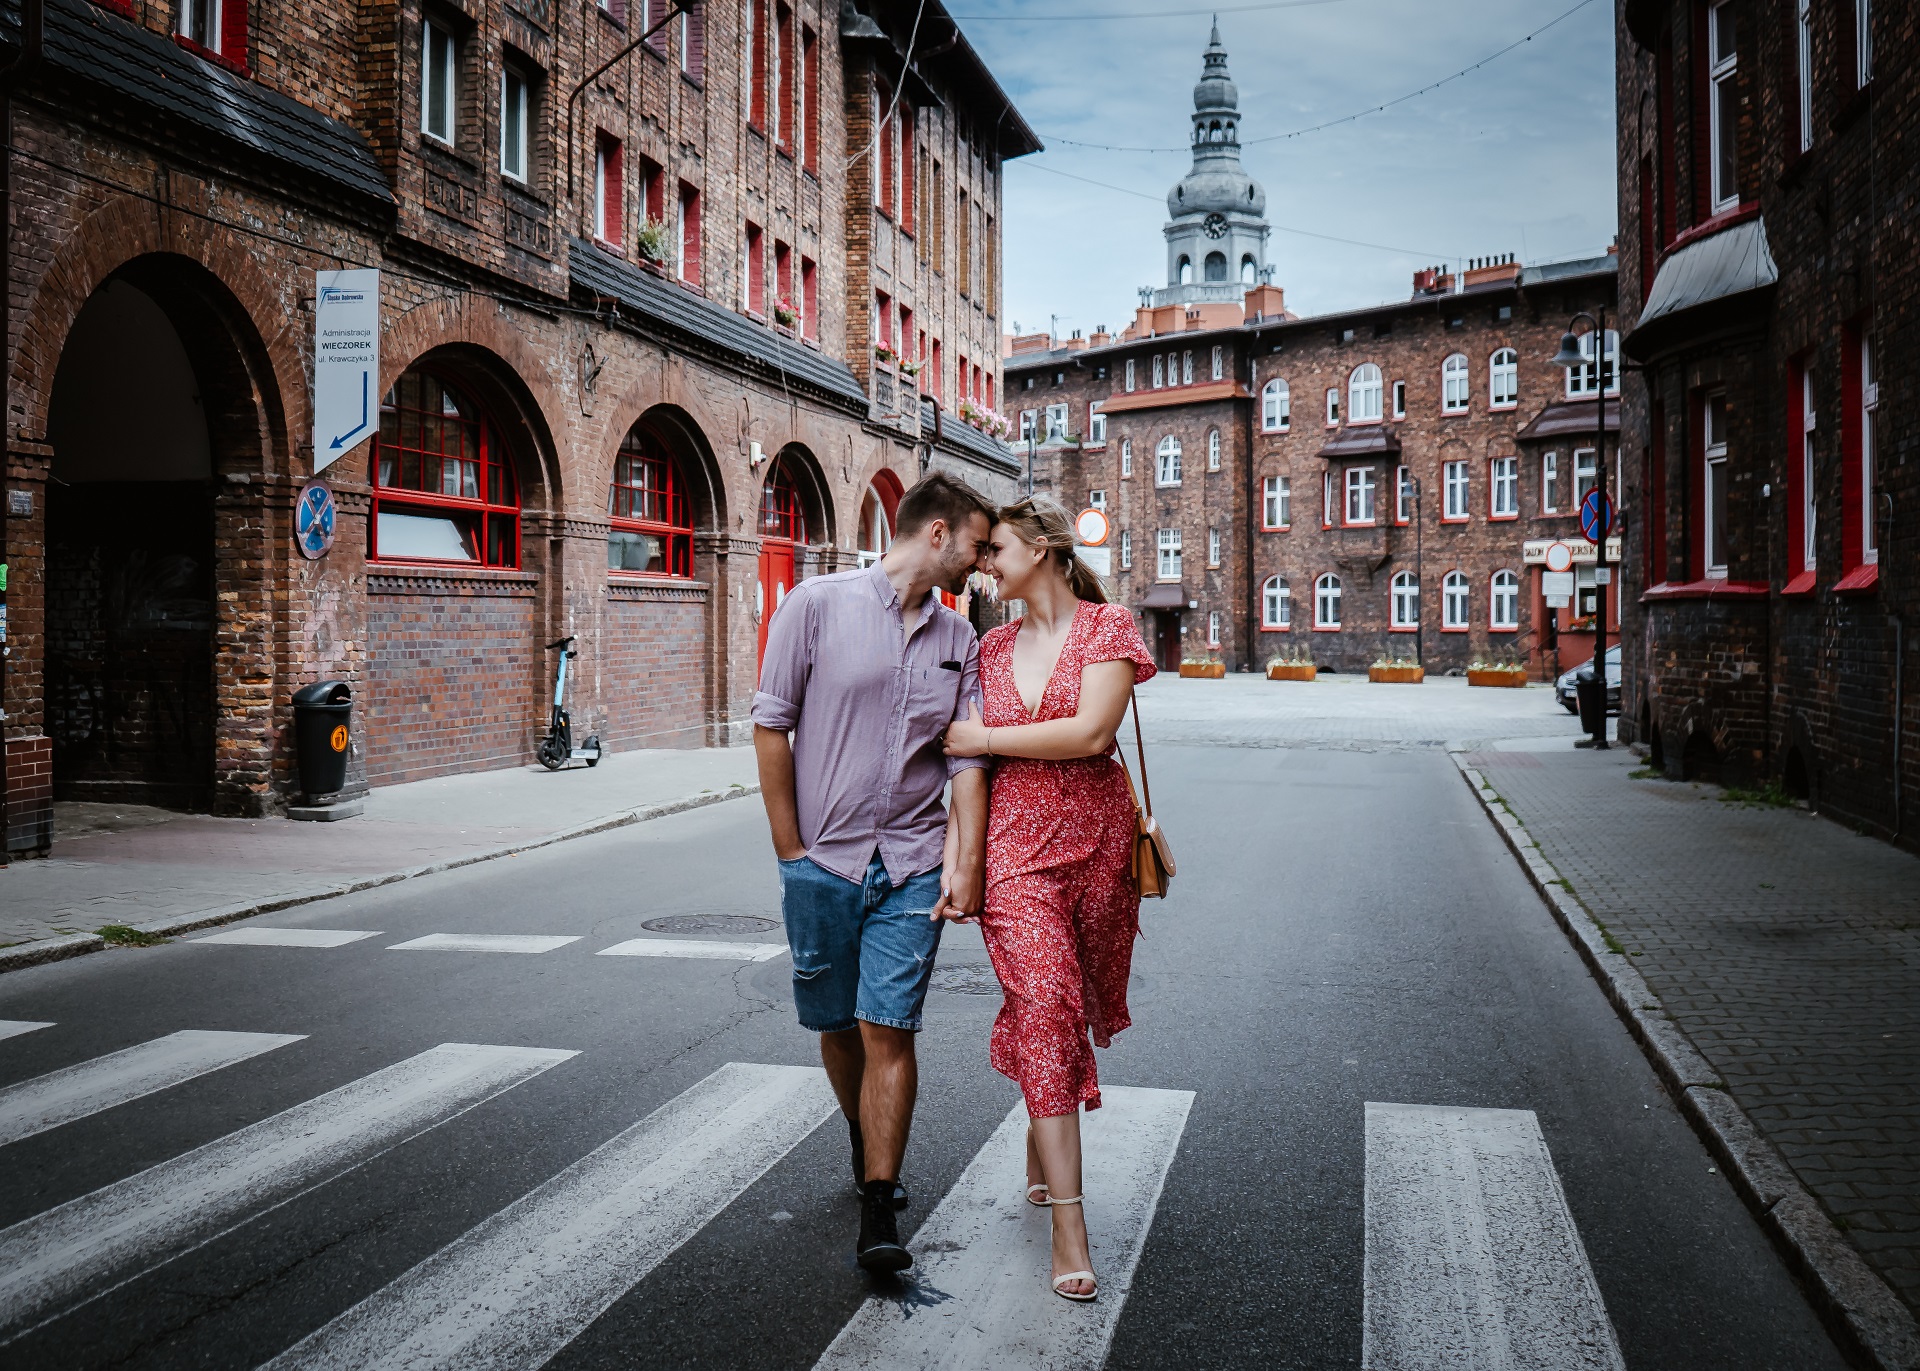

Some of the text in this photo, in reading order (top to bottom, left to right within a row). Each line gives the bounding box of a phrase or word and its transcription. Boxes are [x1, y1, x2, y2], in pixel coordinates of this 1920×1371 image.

[322, 329, 370, 337] Administracja
[321, 341, 371, 349] WIECZOREK
[318, 355, 327, 363] ul.
[328, 355, 368, 363] Krawczyka
